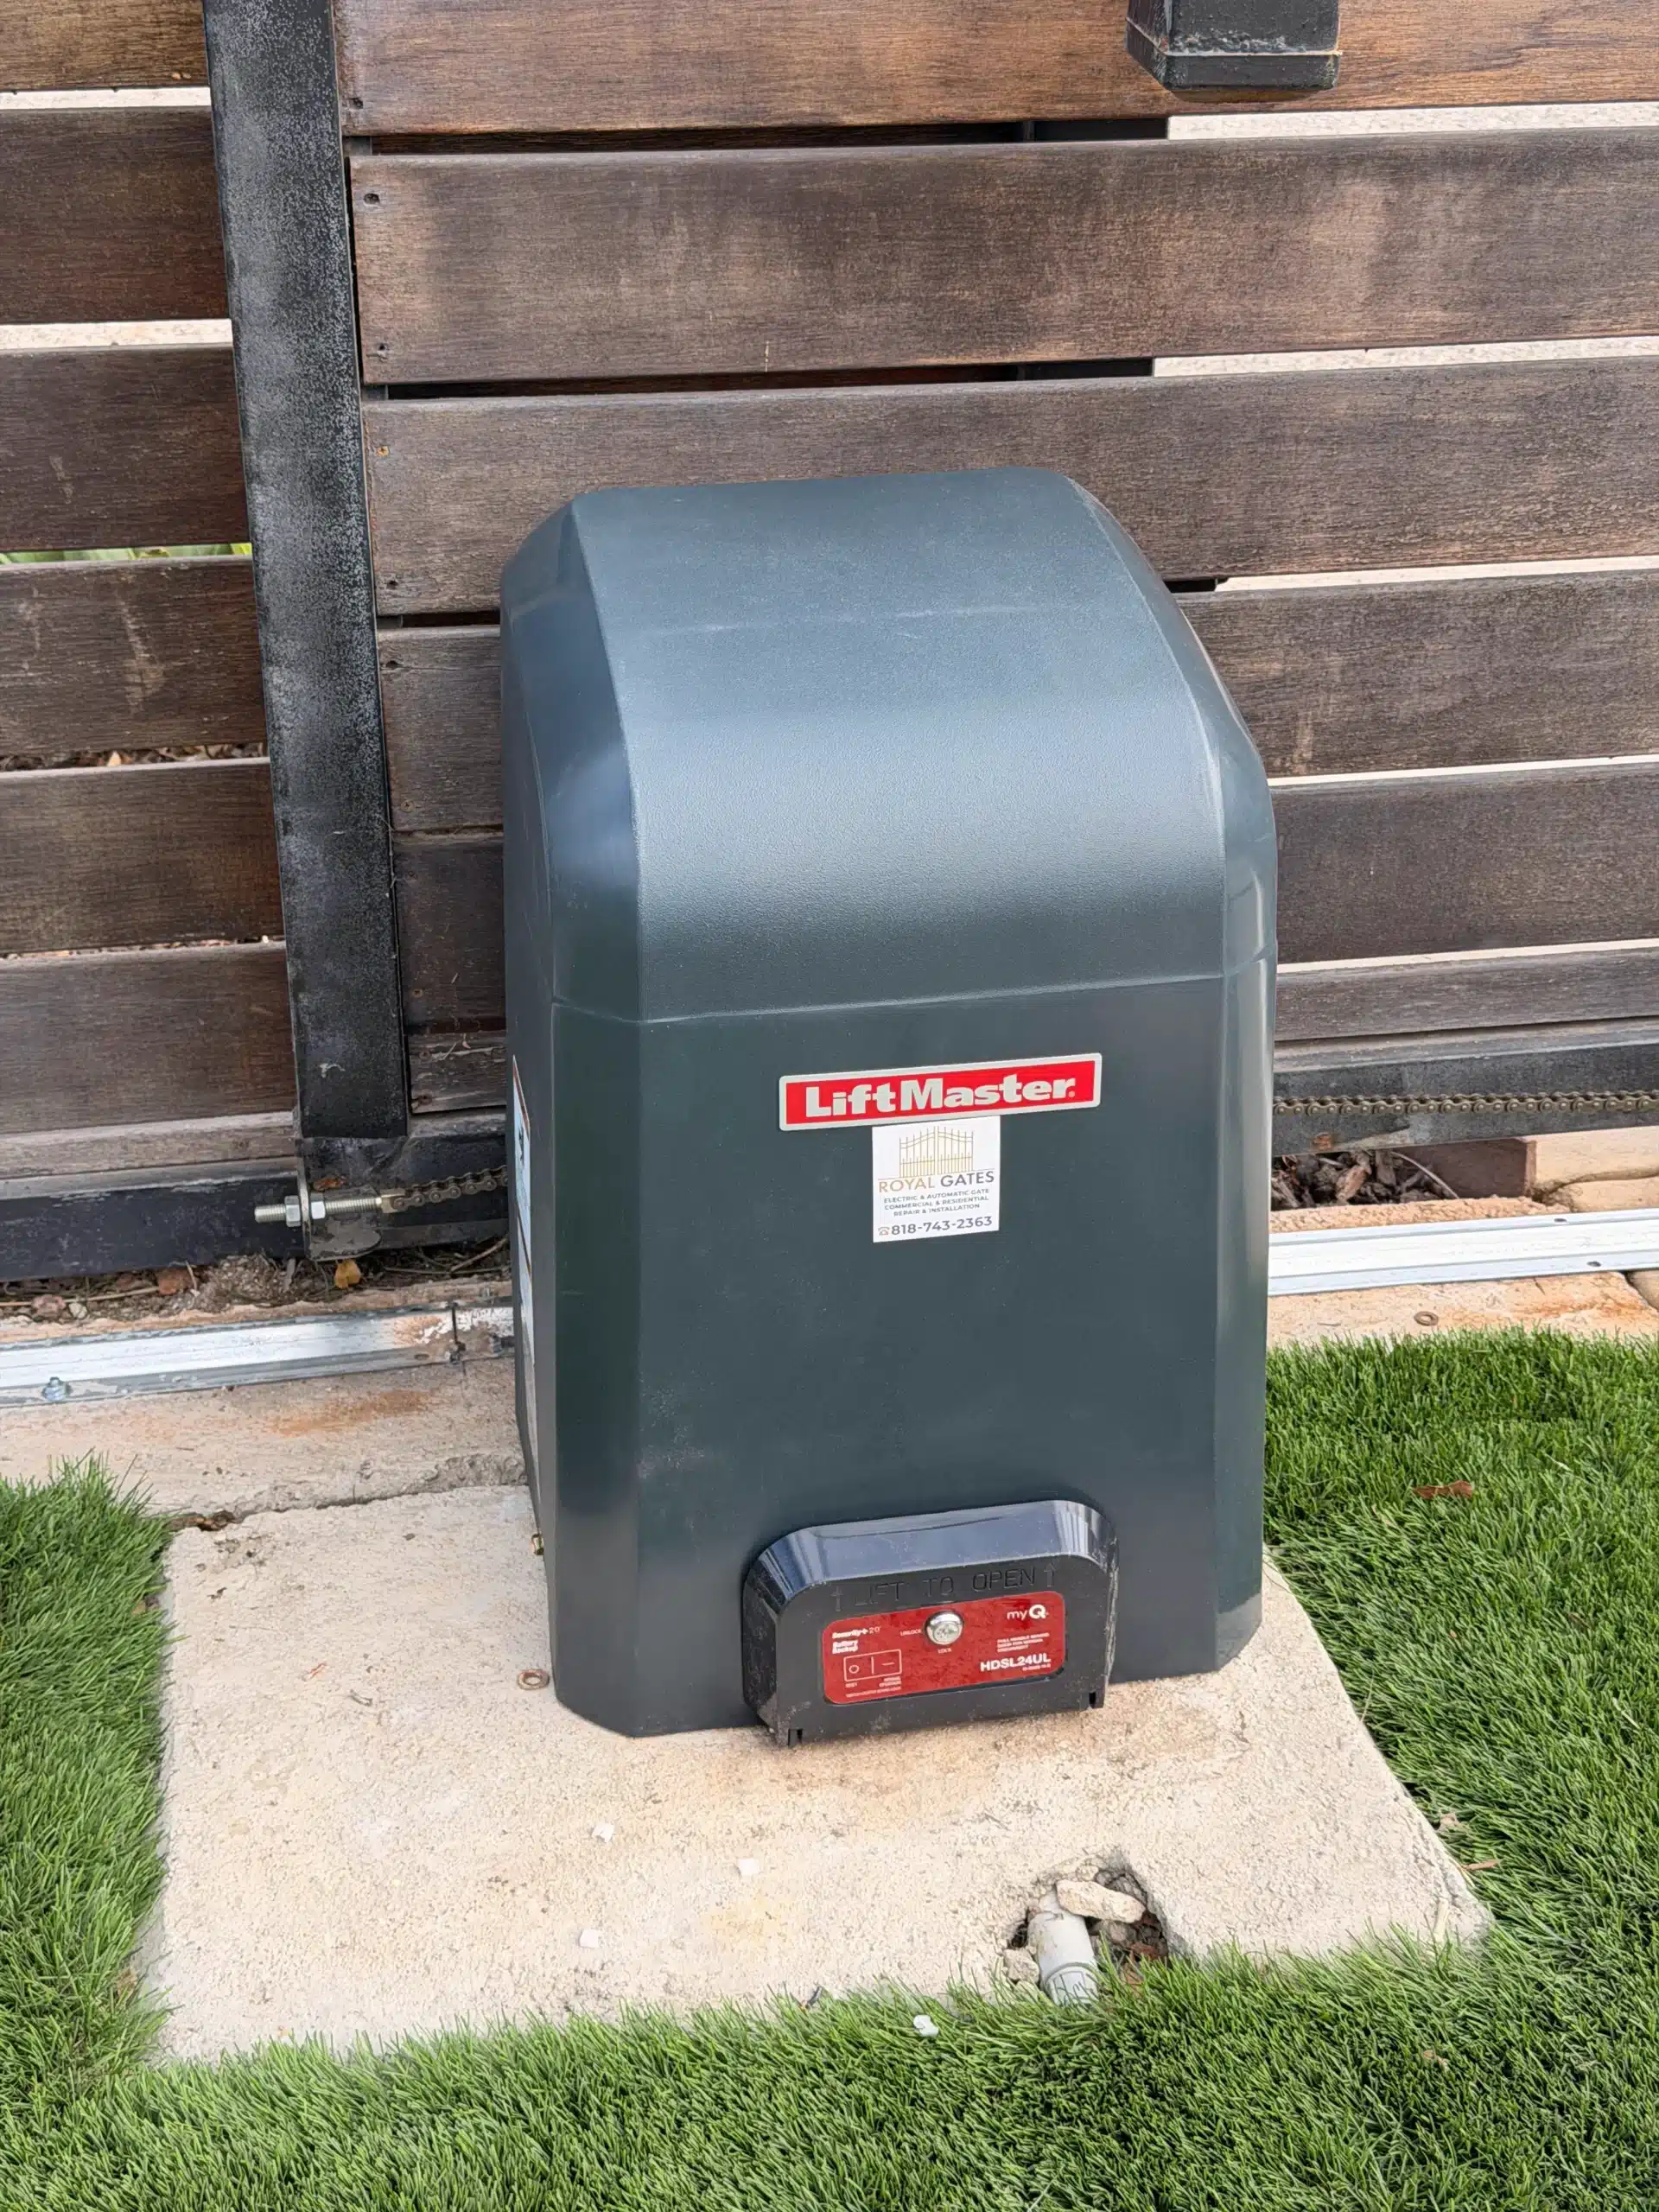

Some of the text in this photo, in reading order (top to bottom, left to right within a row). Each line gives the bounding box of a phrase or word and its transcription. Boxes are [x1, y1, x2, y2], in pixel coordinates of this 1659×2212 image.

[805, 1073, 1076, 1118] LiftMaster
[878, 1171, 995, 1193] ROYAL GATES
[883, 1195, 918, 1204] ELECTRIC
[927, 1190, 969, 1199] AUTOMATIC
[884, 1201, 933, 1211] COMMERCIAL
[943, 1195, 989, 1205] RESIDENTIAL
[929, 1204, 980, 1214] INSTALLATION
[891, 1216, 993, 1236] 818-743-2363
[922, 1576, 955, 1599] TO
[971, 1566, 1036, 1592] OPEN
[980, 1652, 1052, 1672] HDSL24UL
